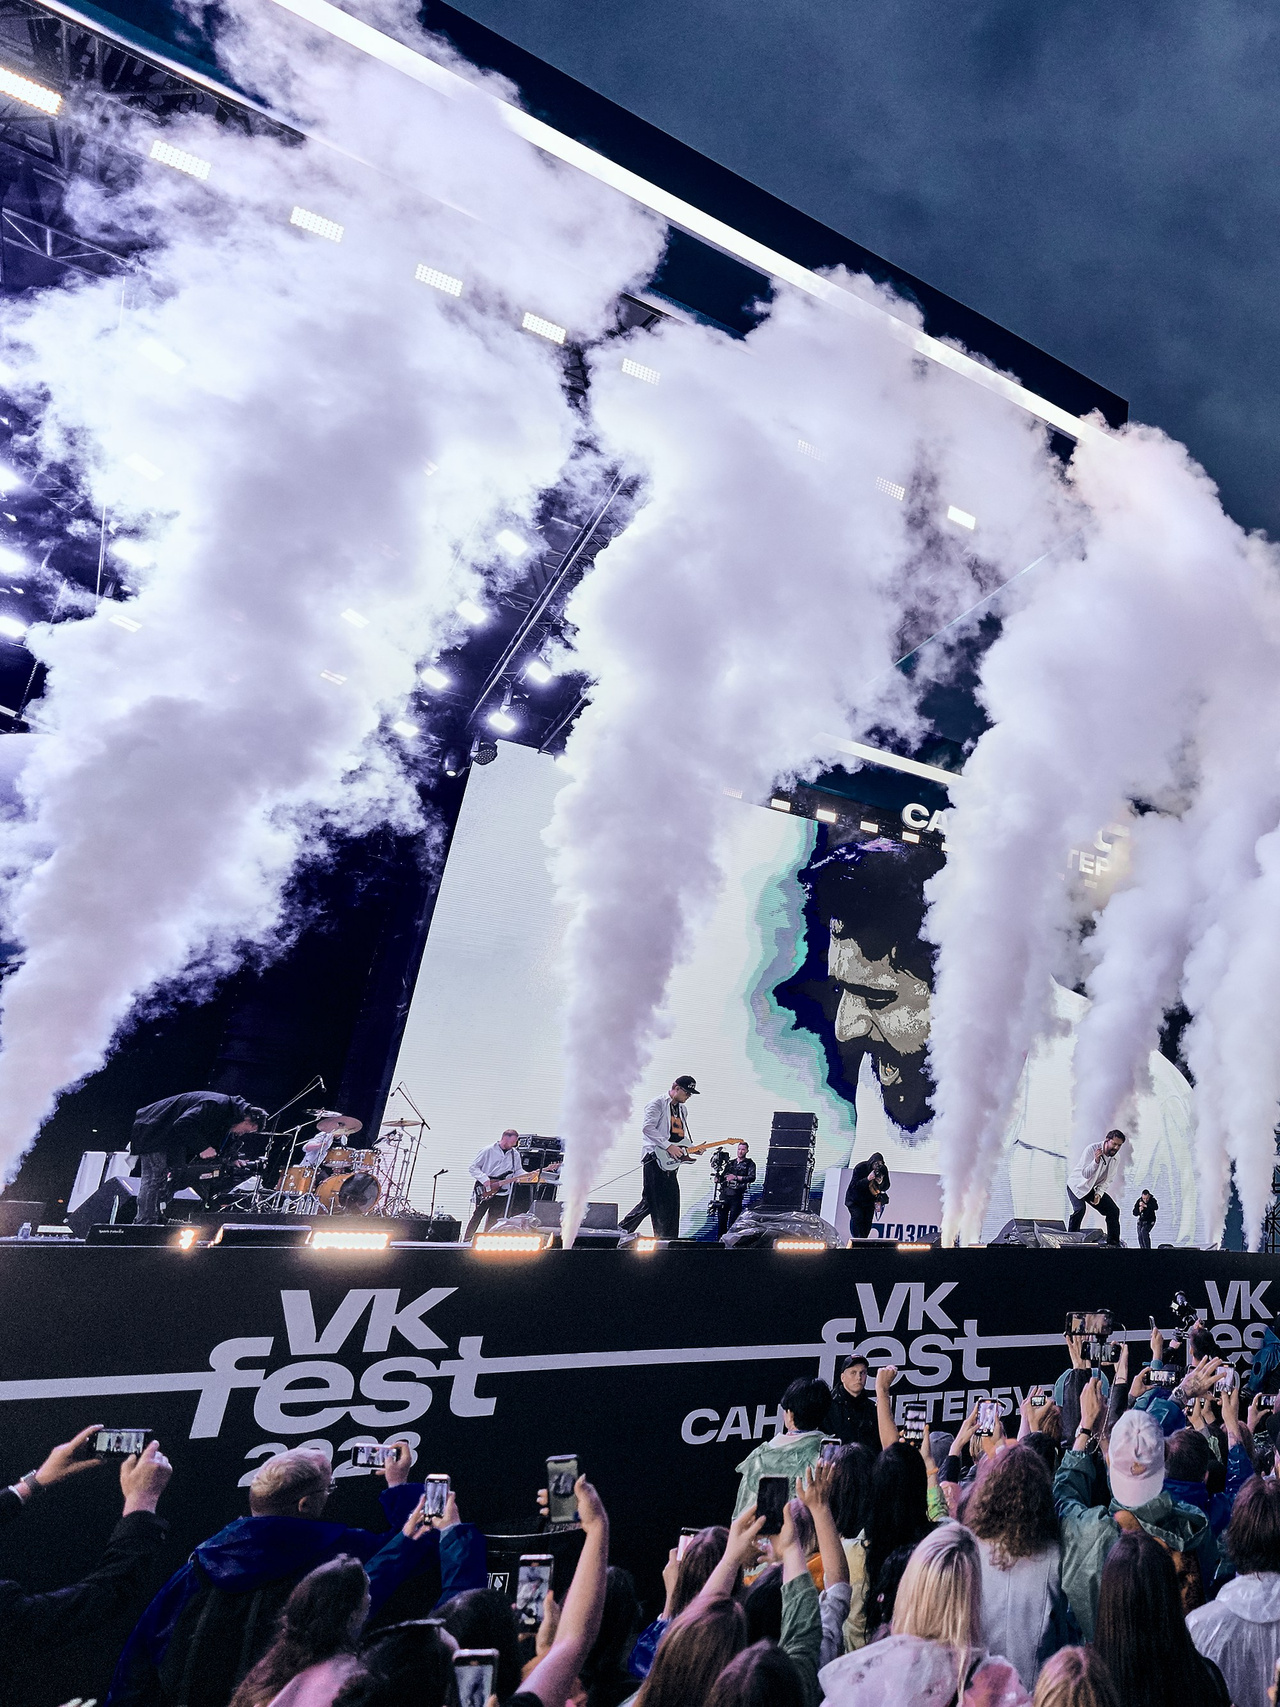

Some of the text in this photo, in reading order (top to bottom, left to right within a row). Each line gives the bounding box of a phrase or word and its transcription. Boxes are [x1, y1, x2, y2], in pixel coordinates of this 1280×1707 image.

[280, 1286, 459, 1356] VK
[855, 1281, 960, 1333] VK
[1204, 1280, 1274, 1321] VK
[189, 1335, 498, 1440] fest
[818, 1317, 991, 1391] fest
